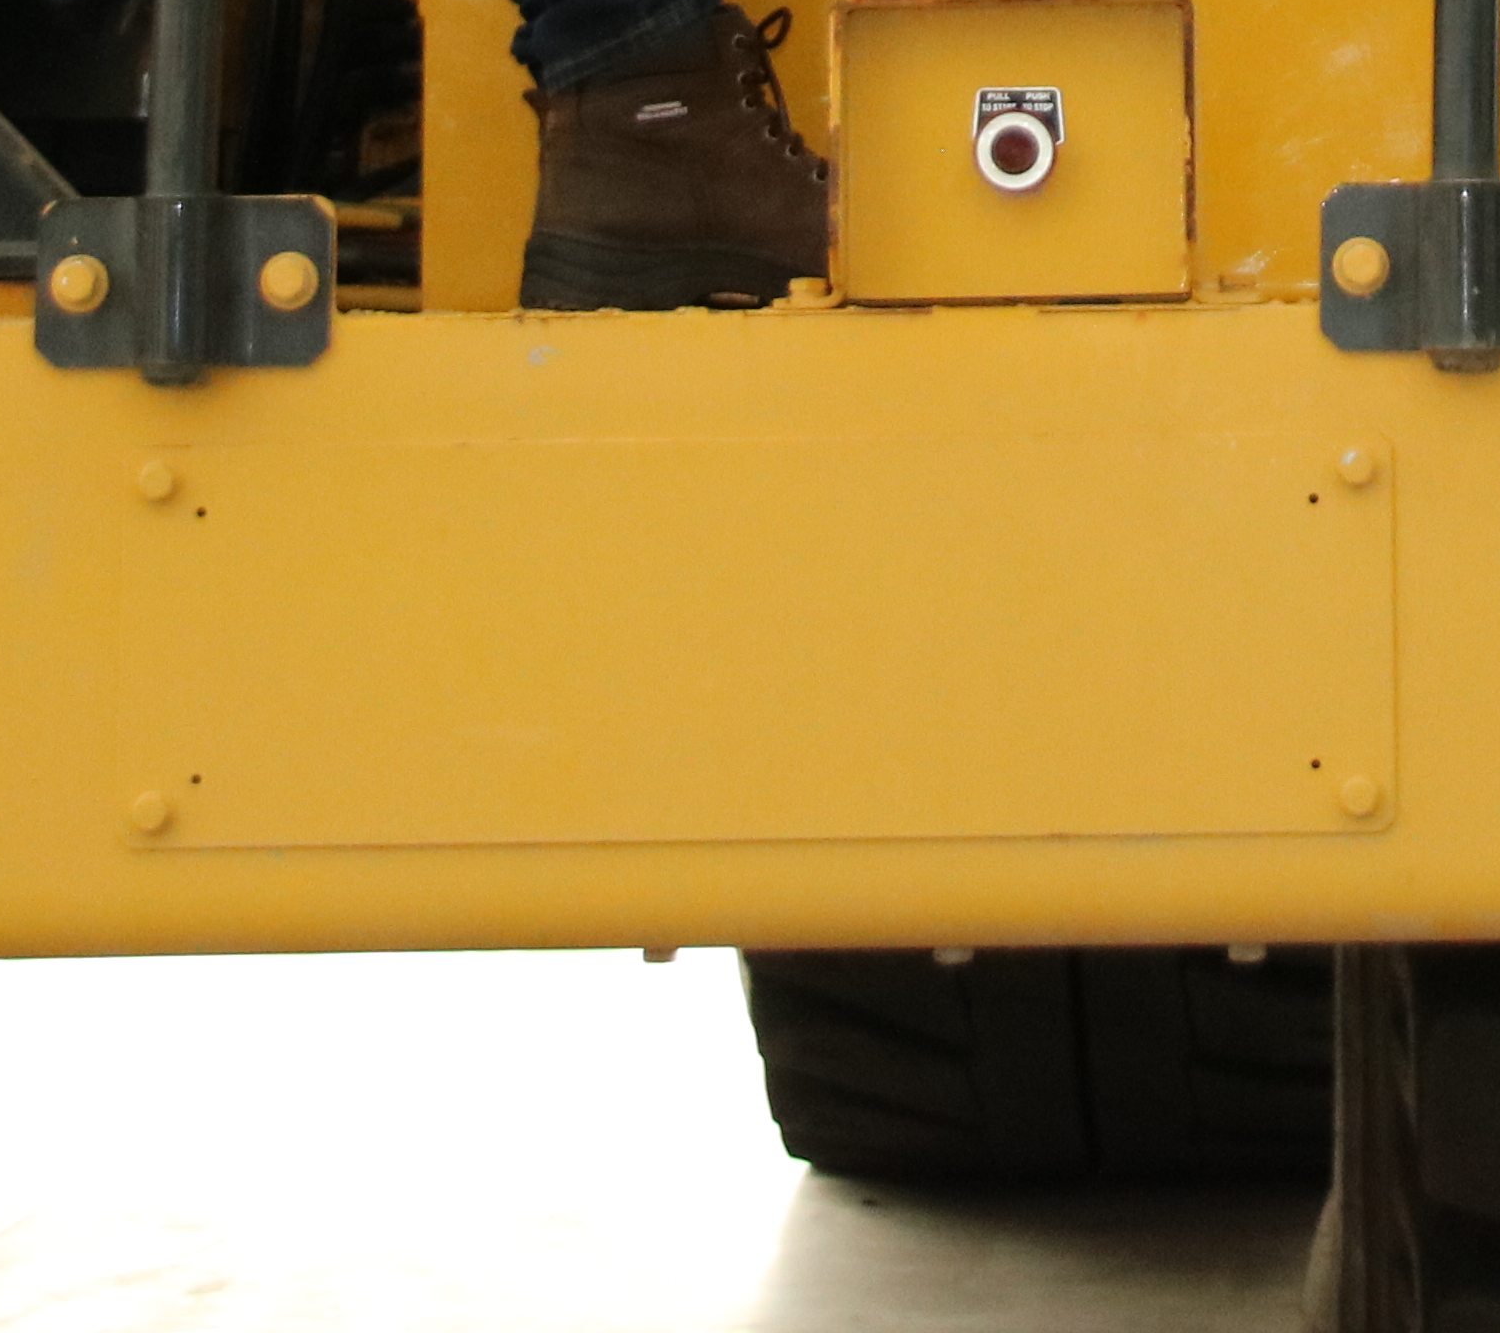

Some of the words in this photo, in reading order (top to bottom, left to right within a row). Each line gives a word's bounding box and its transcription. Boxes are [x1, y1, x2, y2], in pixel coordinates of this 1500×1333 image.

[987, 92, 1011, 101] PULL
[1025, 92, 1051, 101] PUSH
[982, 102, 991, 111] TO
[1023, 102, 1032, 111] TO
[1034, 102, 1054, 111] STOP
